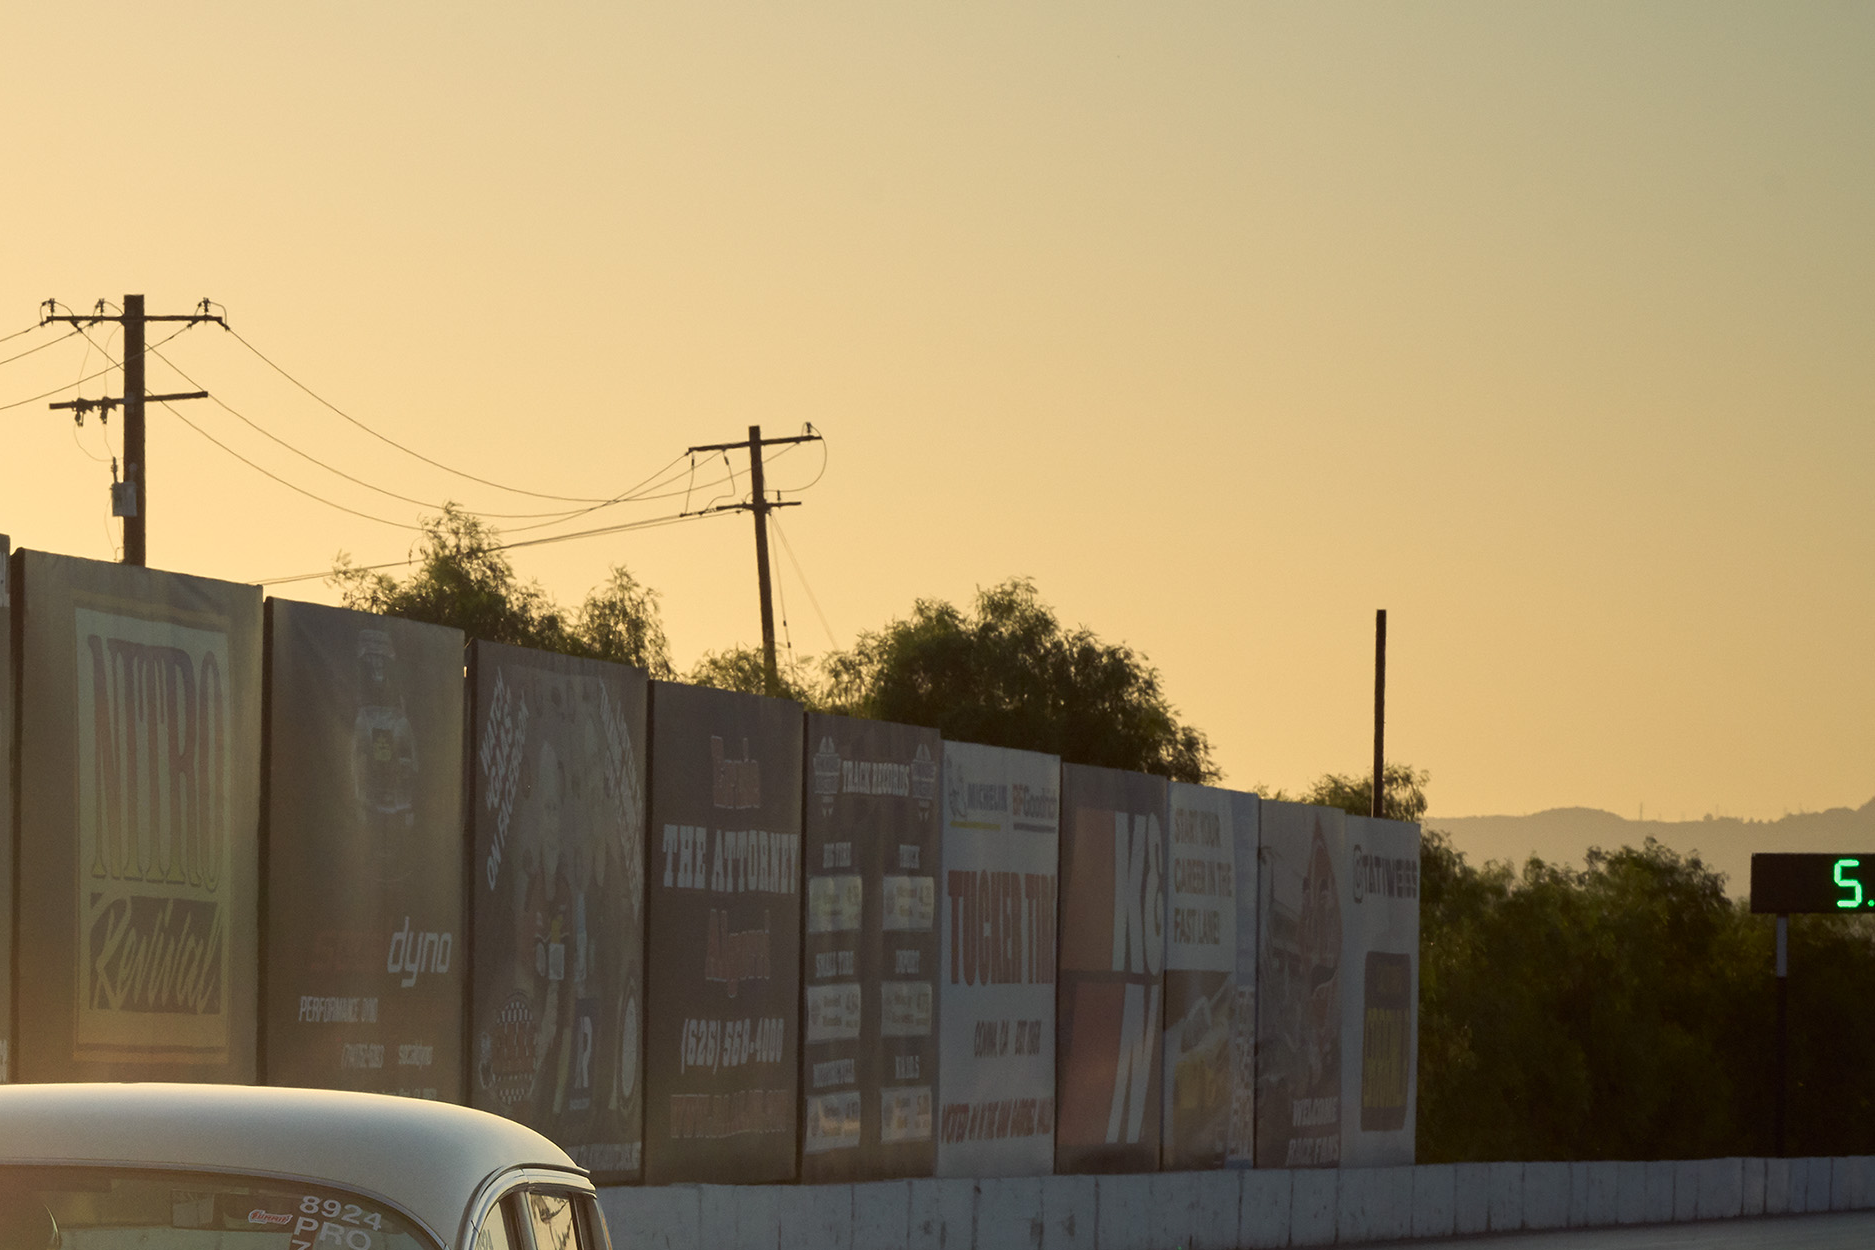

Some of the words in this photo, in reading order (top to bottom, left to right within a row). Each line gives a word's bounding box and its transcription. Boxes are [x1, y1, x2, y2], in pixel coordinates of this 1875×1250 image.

[662, 823, 707, 889] THE
[711, 829, 799, 894] ATTORNEY
[387, 916, 452, 988] dyno
[680, 1018, 721, 1075] (626)
[299, 1195, 382, 1231] 8924
